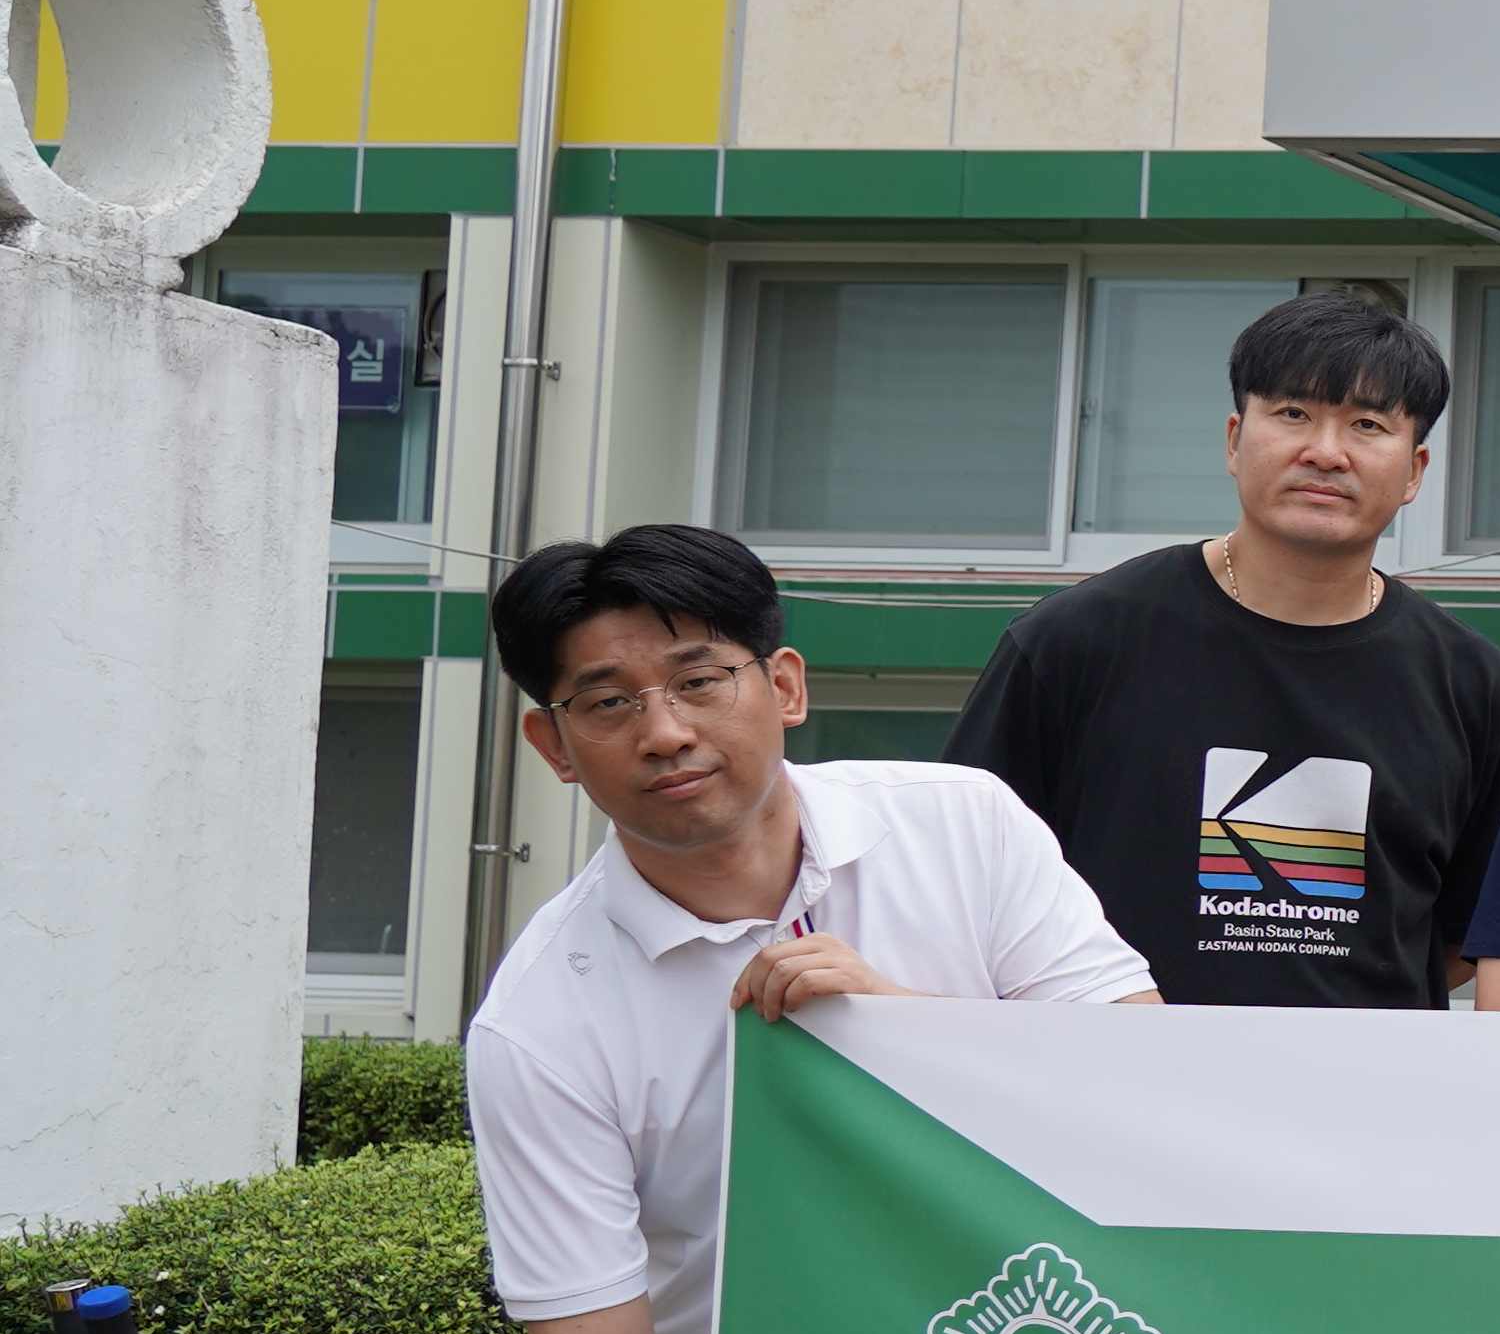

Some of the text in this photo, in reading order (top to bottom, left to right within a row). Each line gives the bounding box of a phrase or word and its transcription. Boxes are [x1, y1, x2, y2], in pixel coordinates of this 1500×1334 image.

[1199, 894, 1360, 924] Kodachrome
[1224, 923, 1336, 942] Basin State Park
[1198, 940, 1351, 957] EASTMAN KODAK COMPANY
